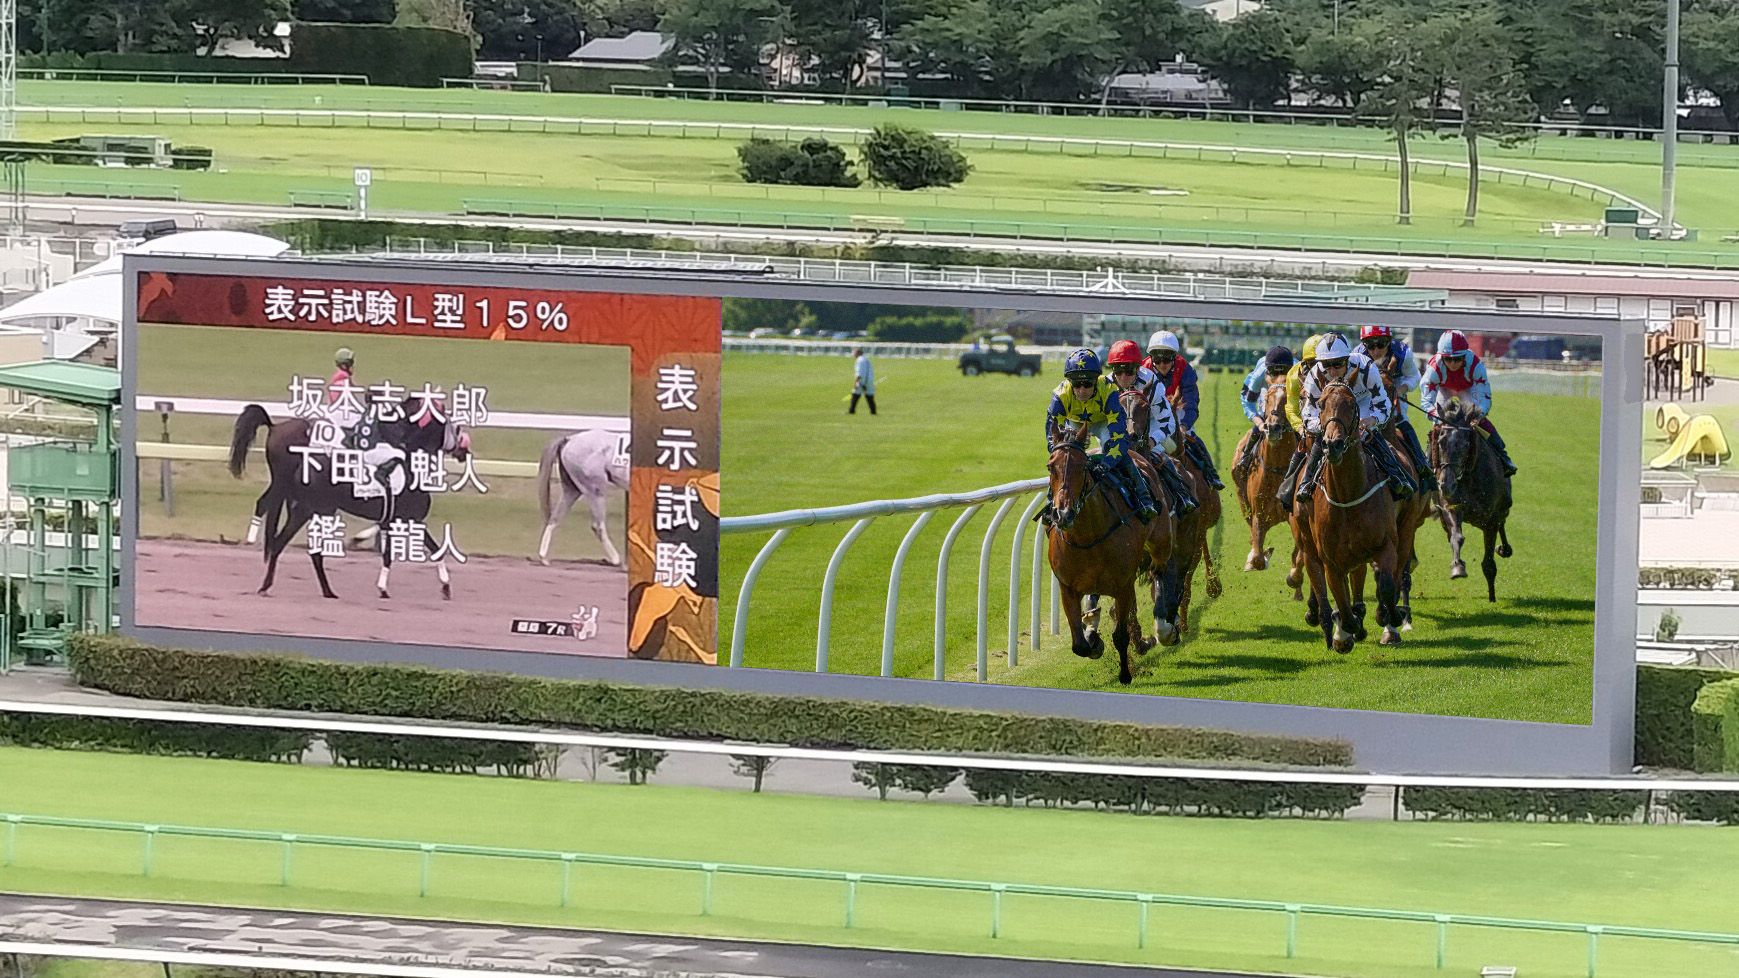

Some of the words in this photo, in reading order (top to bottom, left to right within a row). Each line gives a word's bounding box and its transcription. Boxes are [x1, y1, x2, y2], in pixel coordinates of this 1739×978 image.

[357, 172, 368, 183] 10
[315, 423, 336, 443] 10
[289, 445, 364, 485] 下田
[410, 449, 488, 494] 魁人
[653, 364, 700, 588] 表示試験
[388, 518, 468, 564] 龍人
[546, 622, 567, 636] 7R
